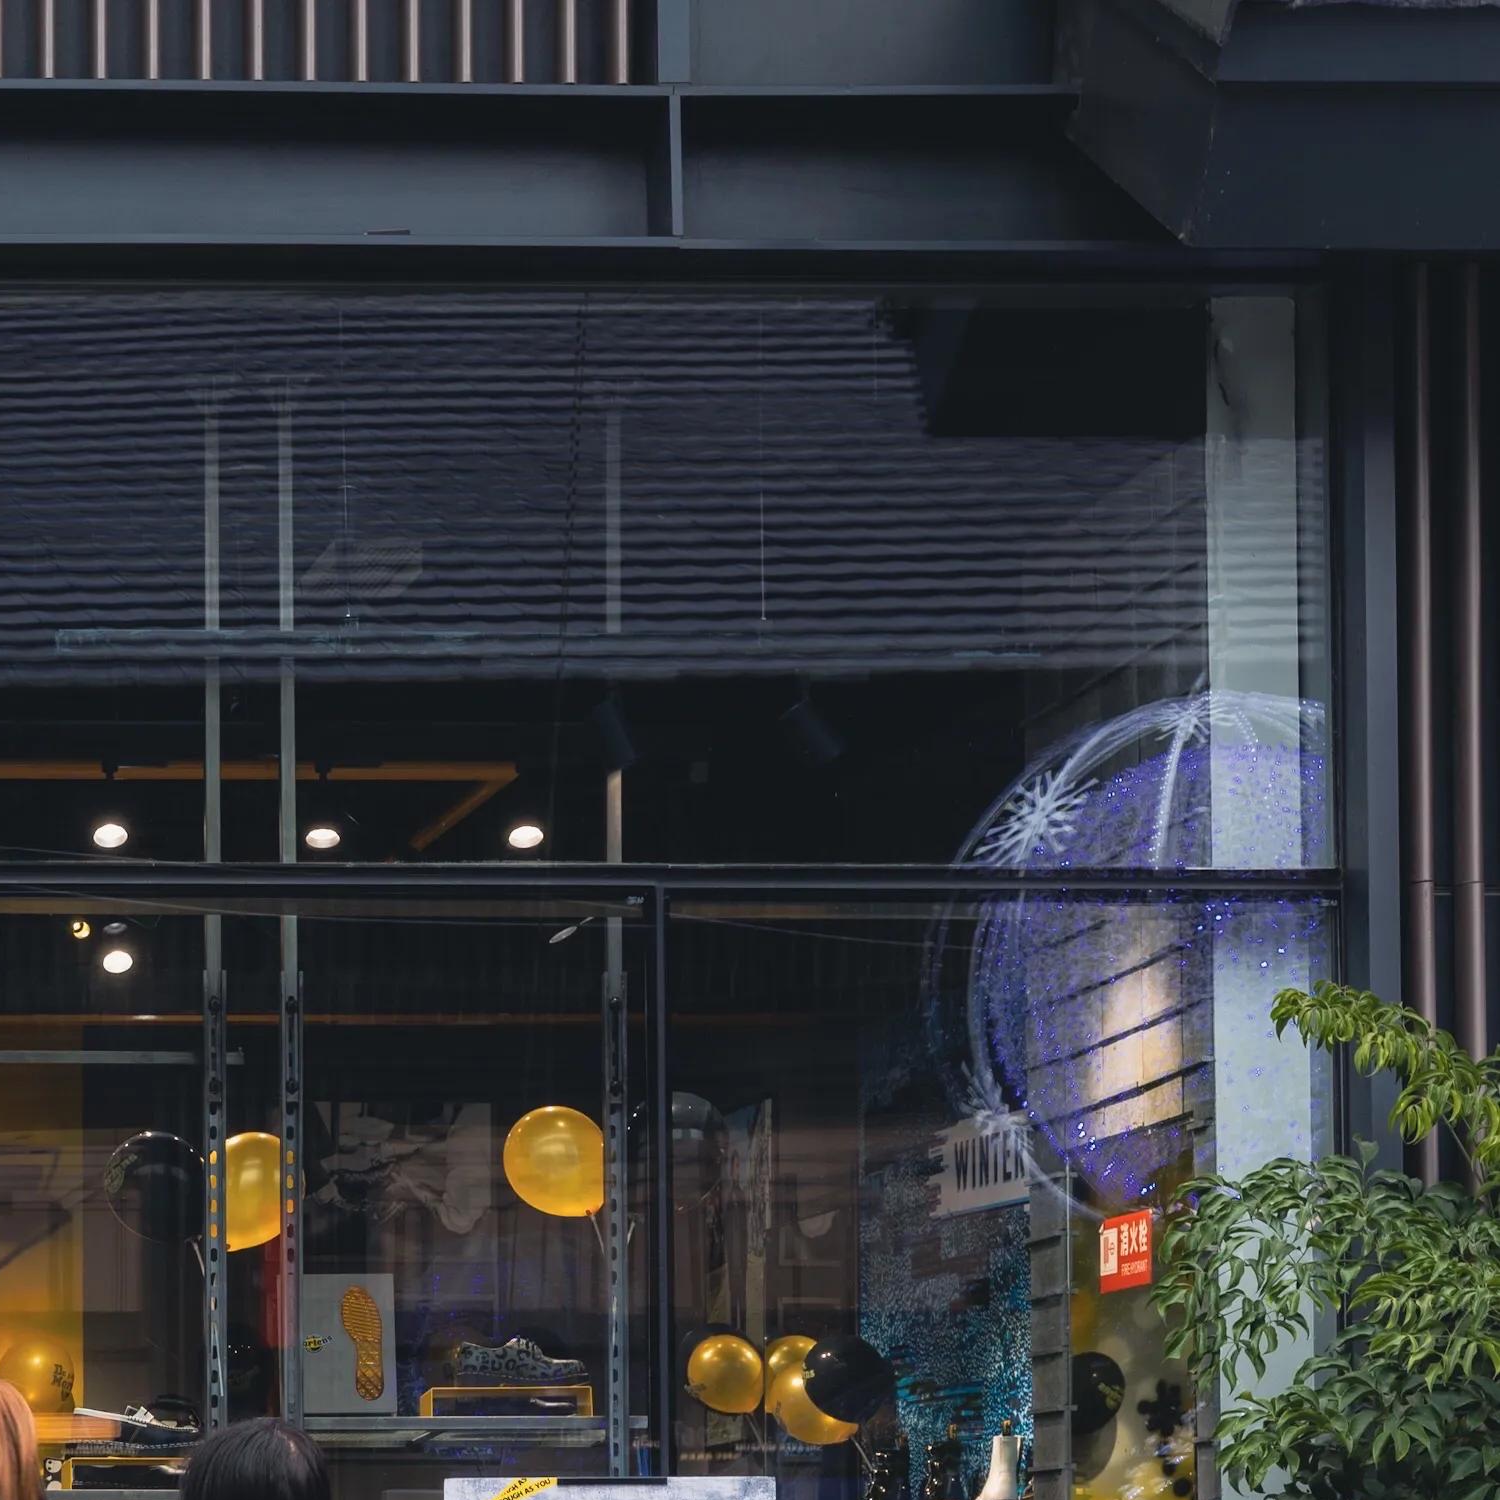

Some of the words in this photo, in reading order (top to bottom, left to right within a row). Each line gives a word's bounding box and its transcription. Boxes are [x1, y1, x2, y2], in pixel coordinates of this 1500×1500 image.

[1120, 1218, 1148, 1256] 消火栓
[524, 1486, 534, 1495] AS
[535, 1478, 551, 1489] YOU
